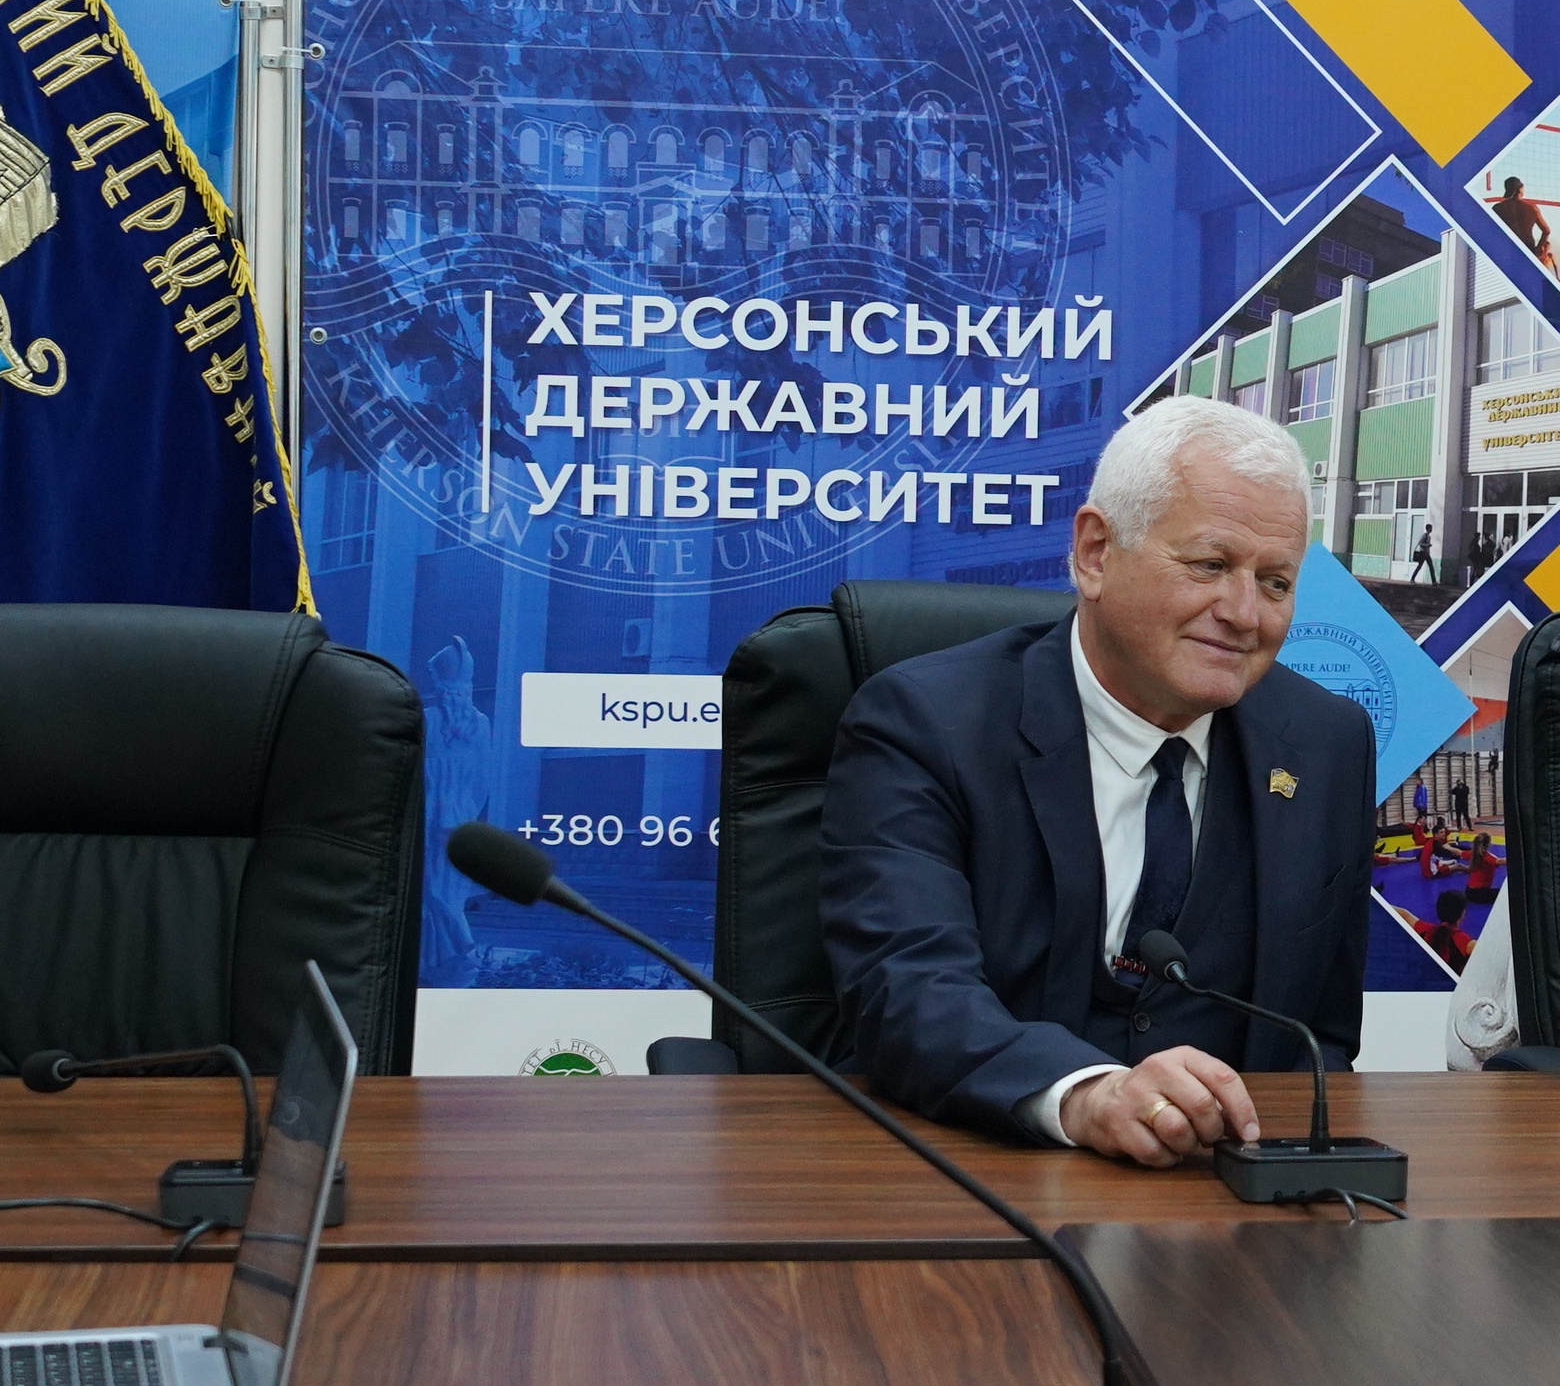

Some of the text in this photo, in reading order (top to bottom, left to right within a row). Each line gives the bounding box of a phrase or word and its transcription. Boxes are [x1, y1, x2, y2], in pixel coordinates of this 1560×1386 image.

[68, 109, 280, 518] ДЕРЖАВНЙ
[526, 291, 1114, 361] ХЕРСОНСЬКИЙ
[524, 373, 1042, 442] ДЕРЖАВНИЙ
[526, 461, 1060, 526] УНІВЕРСИТЕТ
[546, 522, 696, 577] STATE
[1289, 626, 1394, 720] ЕРЖАВНИЙ УНІВЕРСИТЕТ
[1319, 663, 1351, 673] AUDE!
[518, 814, 624, 847] +380
[639, 815, 693, 847] 96
